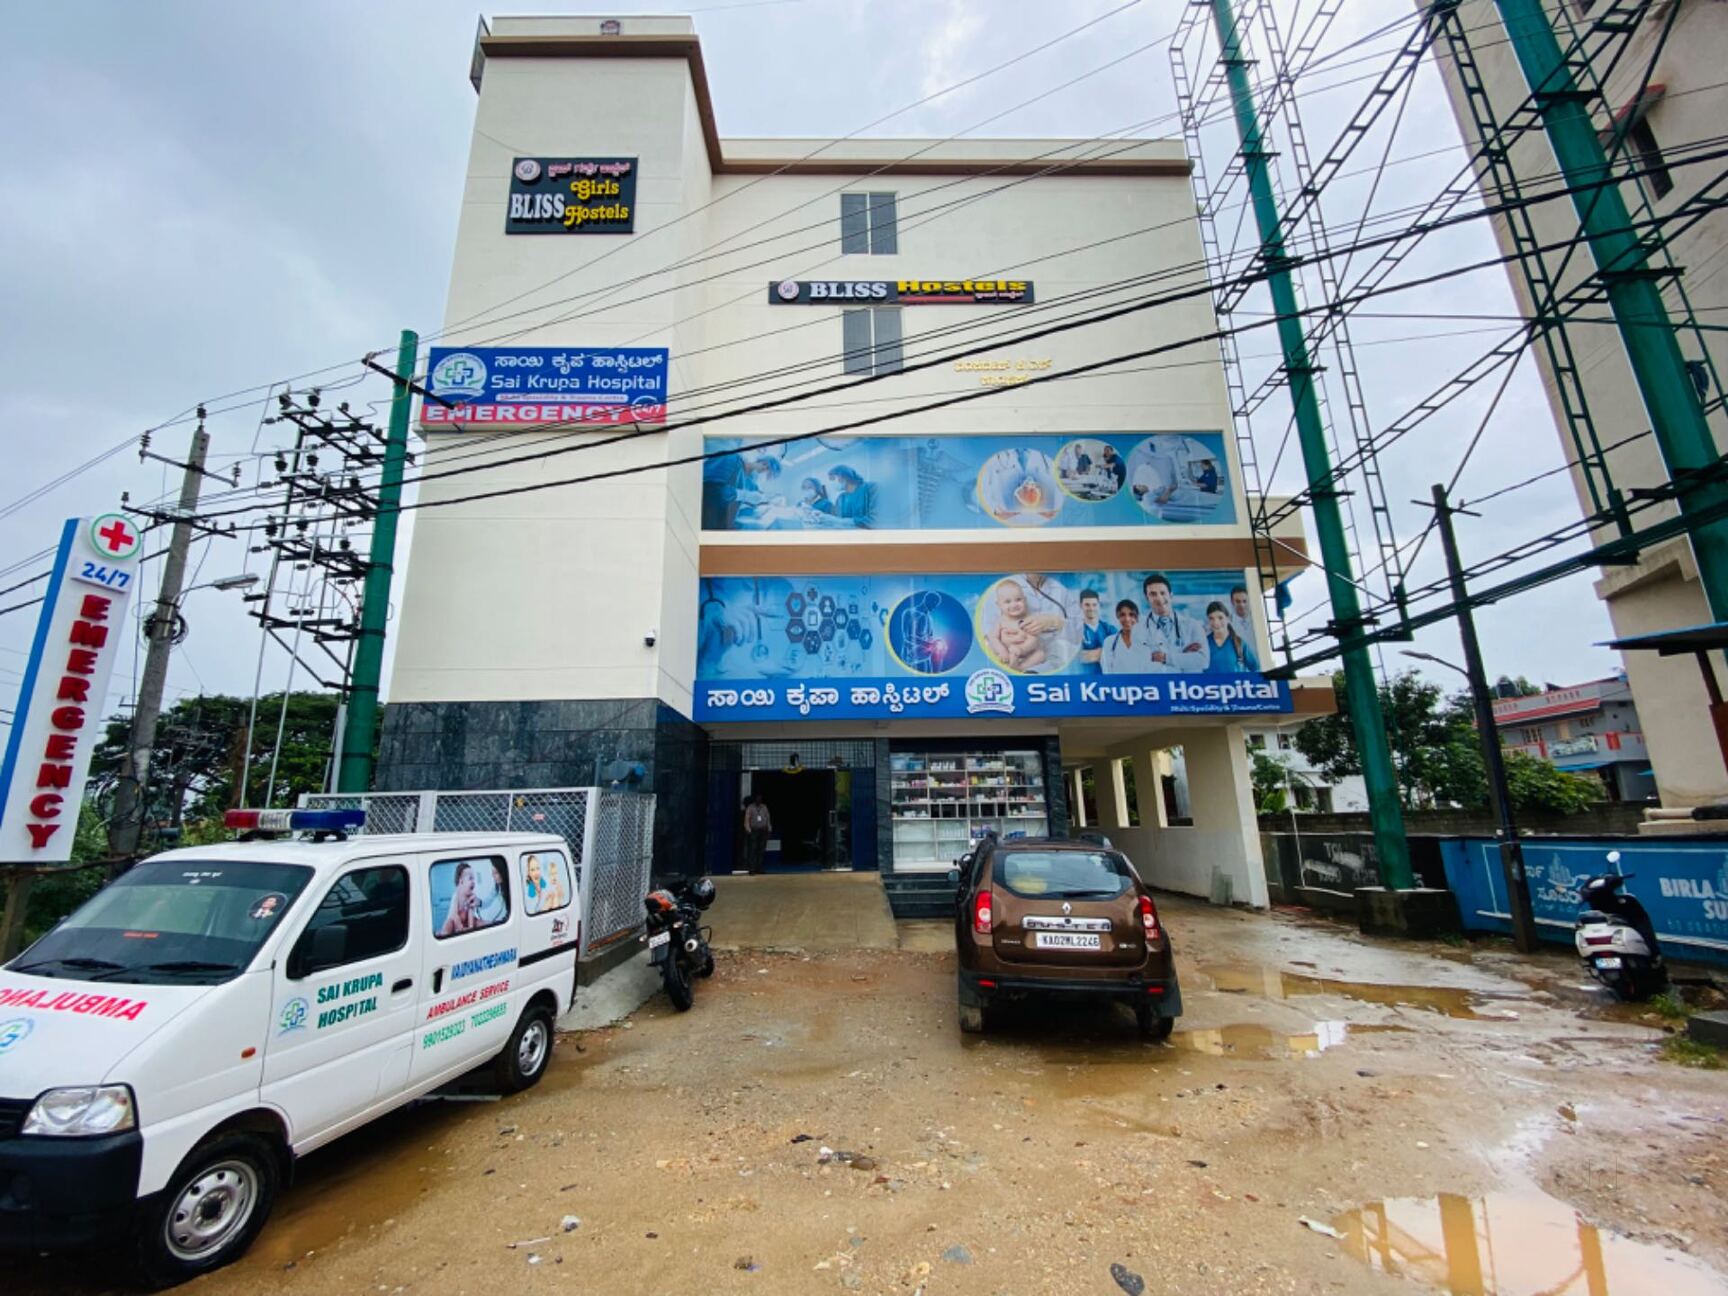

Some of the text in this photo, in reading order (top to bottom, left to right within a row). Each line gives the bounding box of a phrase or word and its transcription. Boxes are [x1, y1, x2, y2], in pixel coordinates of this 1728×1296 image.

[570, 179, 619, 199] Girls
[510, 193, 629, 226] BLISS Hostels
[809, 279, 1027, 298] BLISS Hostels
[491, 375, 661, 392] Sai Krupa Hospital
[81, 562, 131, 588] 24/7
[707, 689, 775, 708] ಸಾಯಿ
[1026, 679, 1279, 705] Sai Krupa Hospital
[26, 594, 112, 850] EMERGENCY
[1659, 877, 1715, 899] BIRLA
[317, 972, 383, 1004] SAI KRUPA
[426, 980, 510, 1020] AMBULANCE SERVICE
[317, 997, 377, 1029] HOSPITAL
